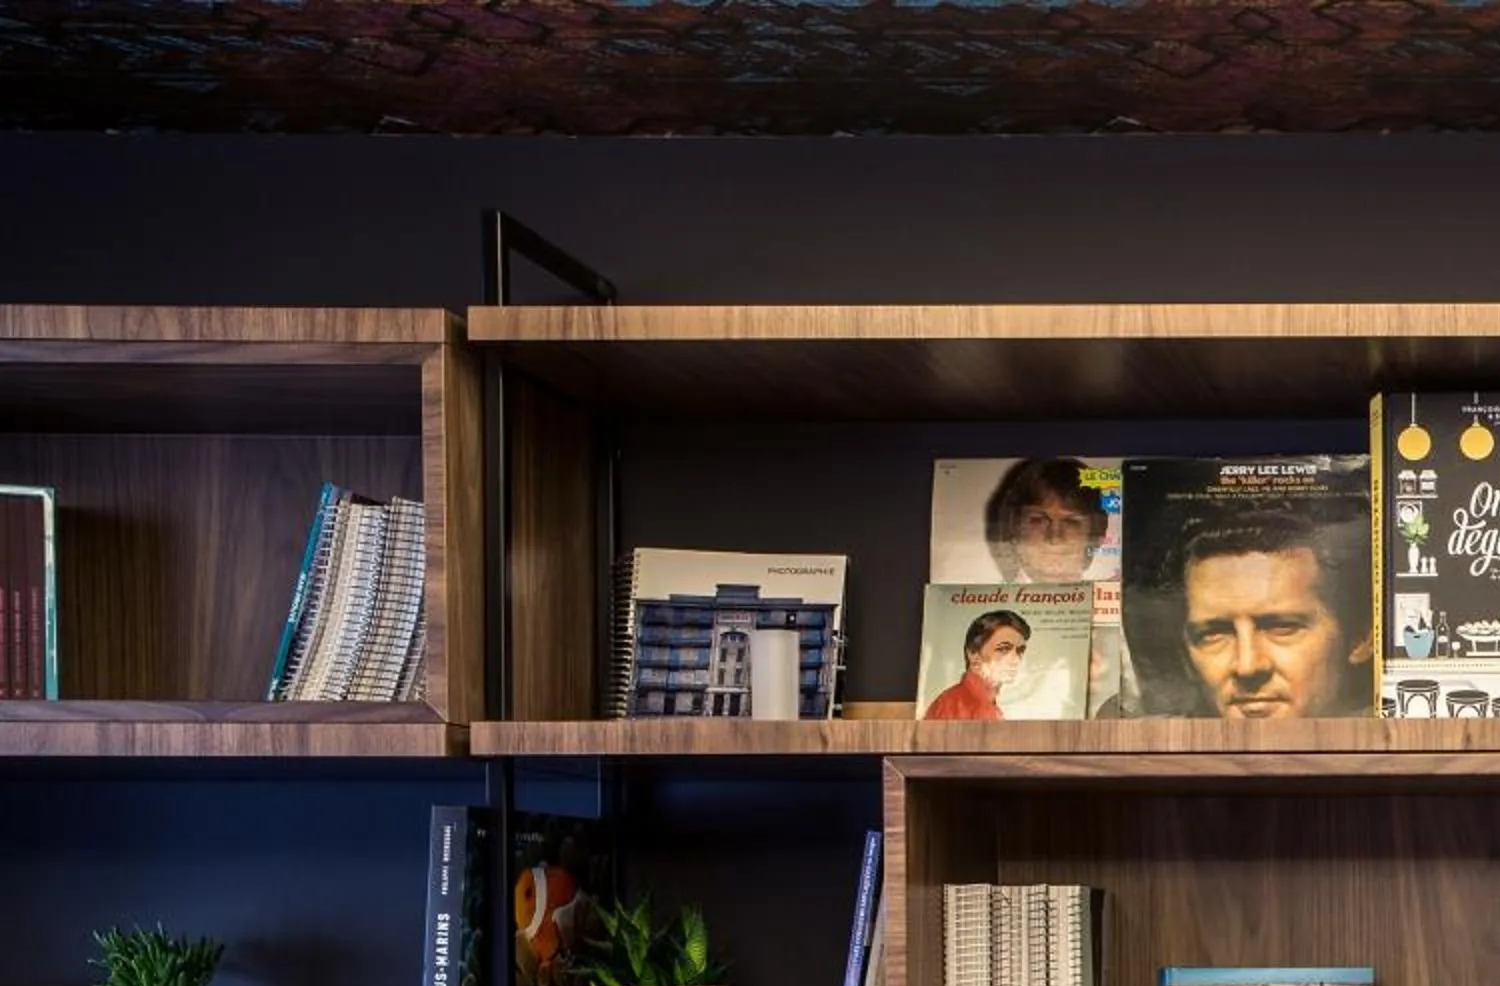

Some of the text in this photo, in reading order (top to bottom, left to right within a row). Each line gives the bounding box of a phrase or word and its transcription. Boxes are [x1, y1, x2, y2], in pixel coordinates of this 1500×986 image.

[1219, 464, 1317, 475] JERRY LEE LEWIS
[767, 567, 835, 576] PHOTOGRAPHIE
[951, 587, 1009, 605] claude
[1015, 586, 1085, 605] françois
